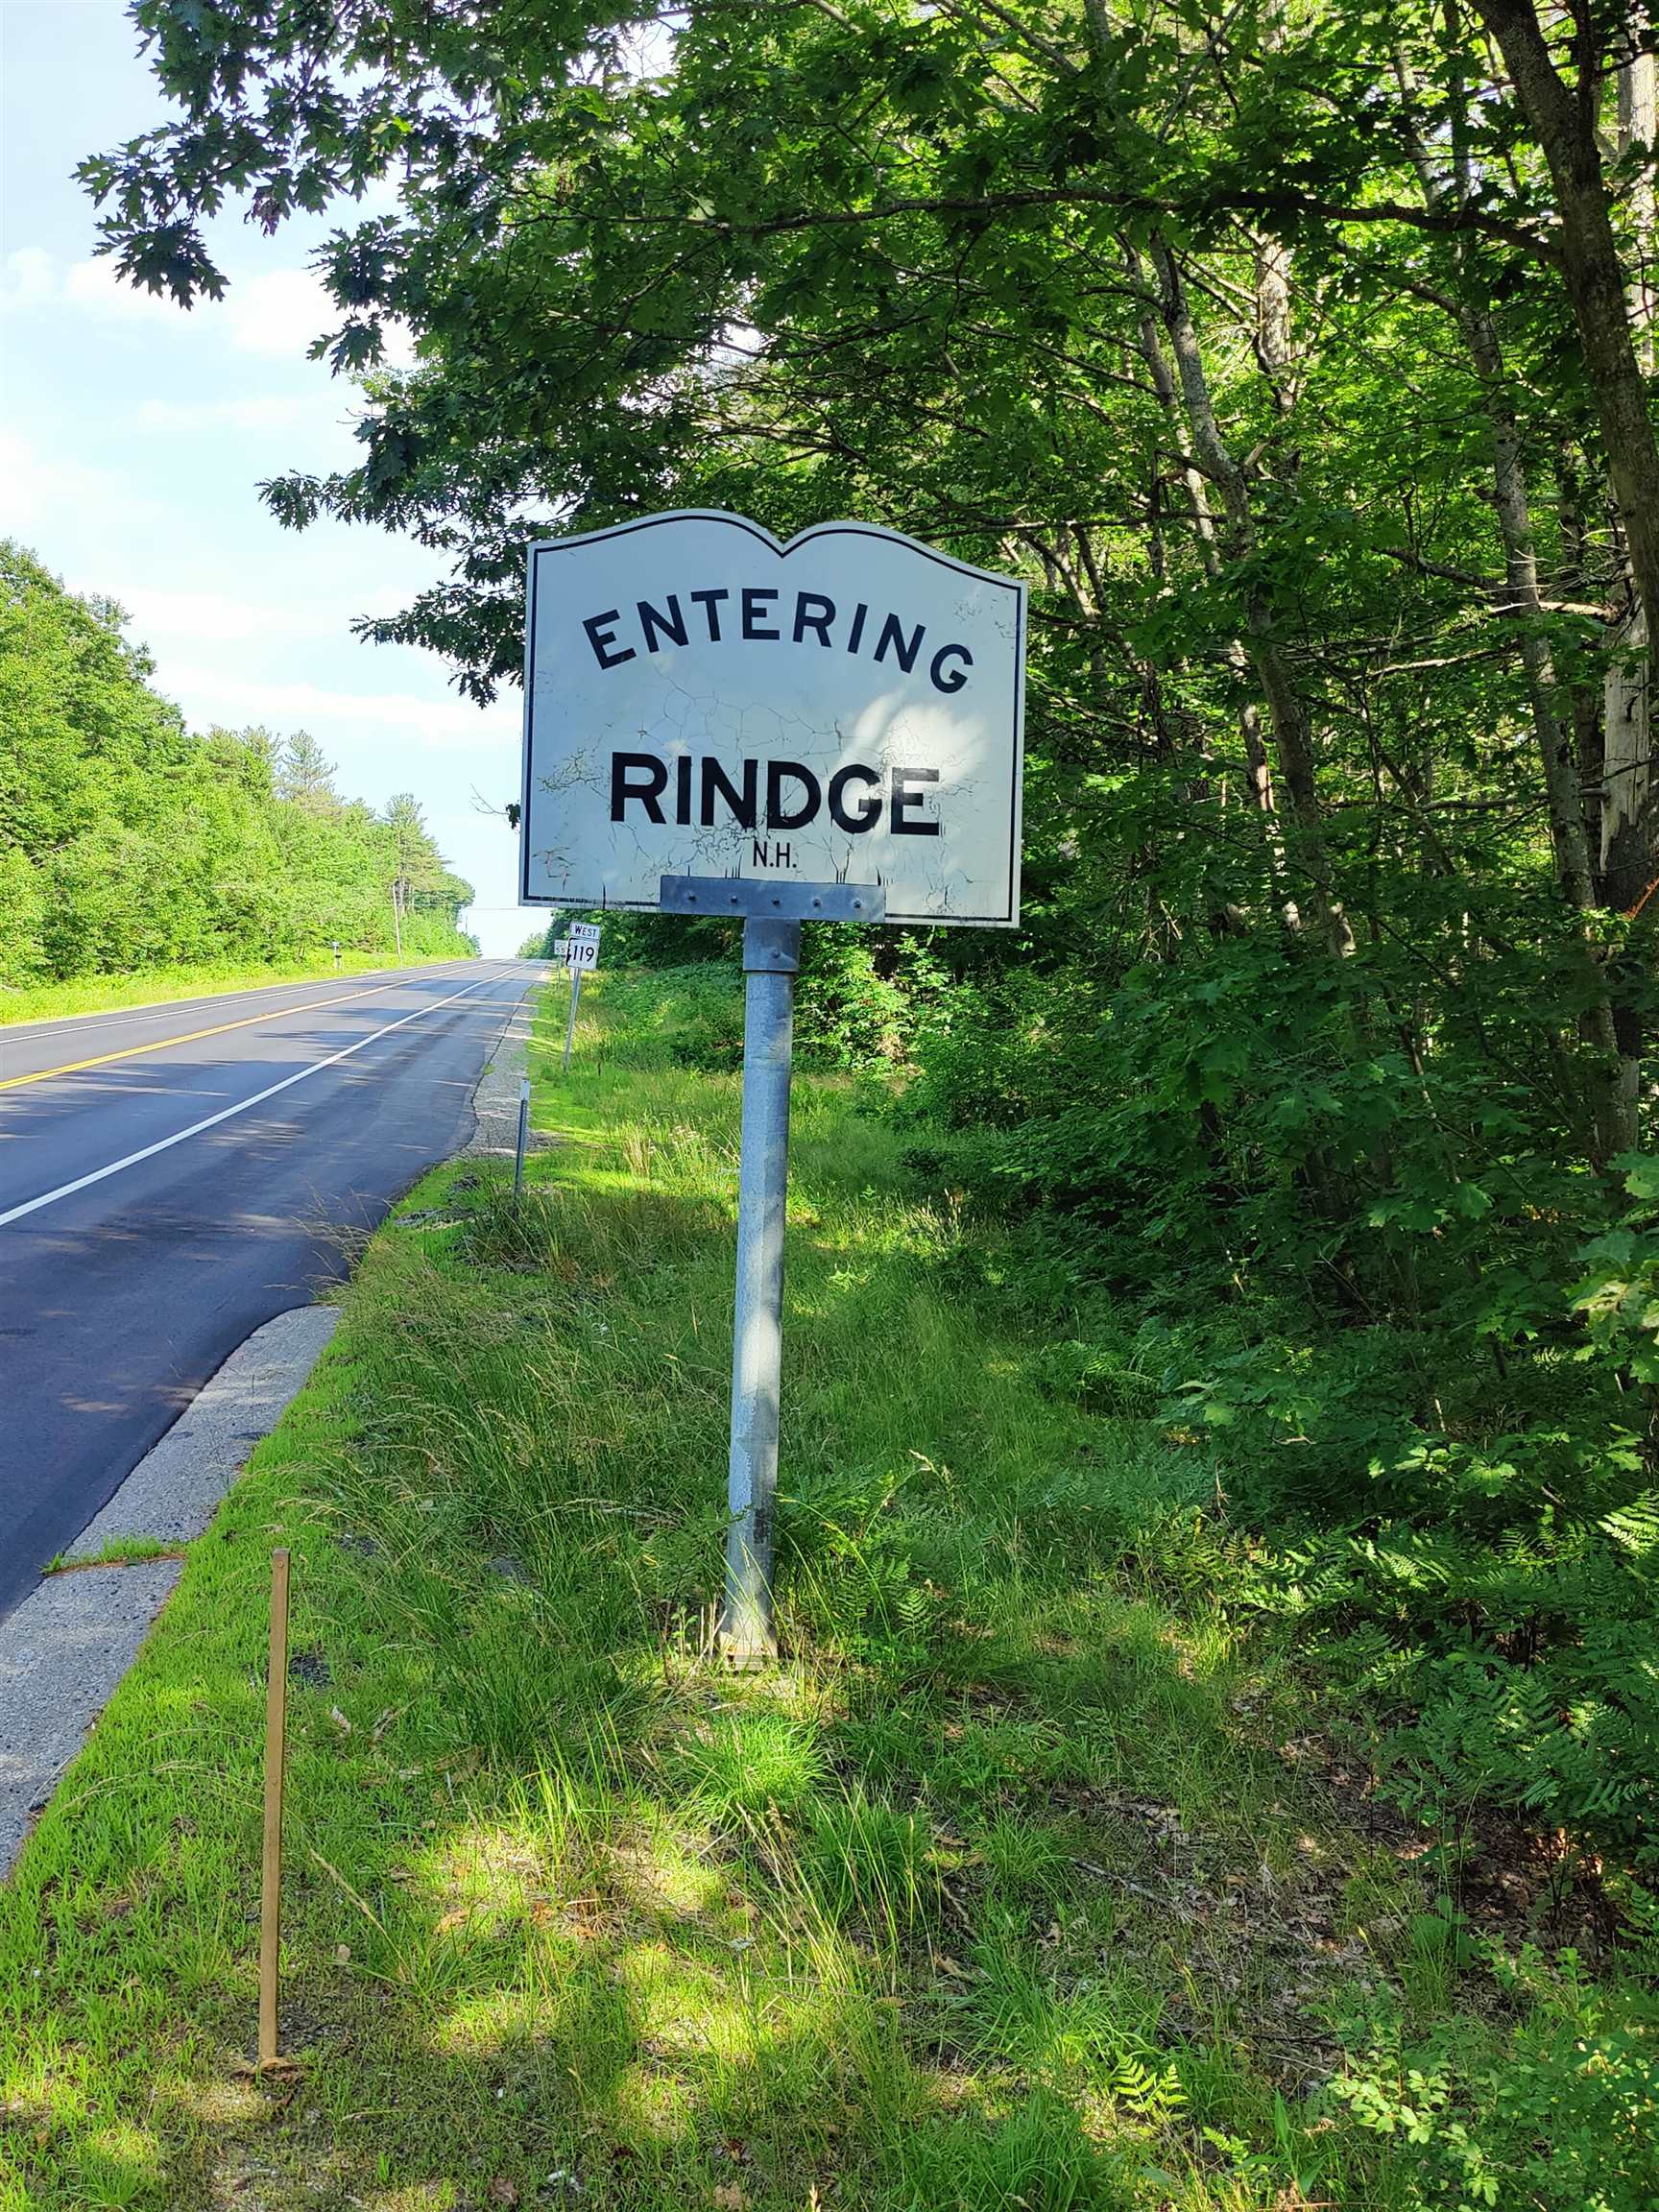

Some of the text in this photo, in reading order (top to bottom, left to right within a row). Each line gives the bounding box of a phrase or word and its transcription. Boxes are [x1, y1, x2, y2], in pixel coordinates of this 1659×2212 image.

[583, 589, 974, 693] ENTERING
[611, 752, 939, 835] RINDGE
[753, 840, 797, 868] N.H.
[575, 925, 597, 937] WEST
[573, 945, 594, 962] 119
